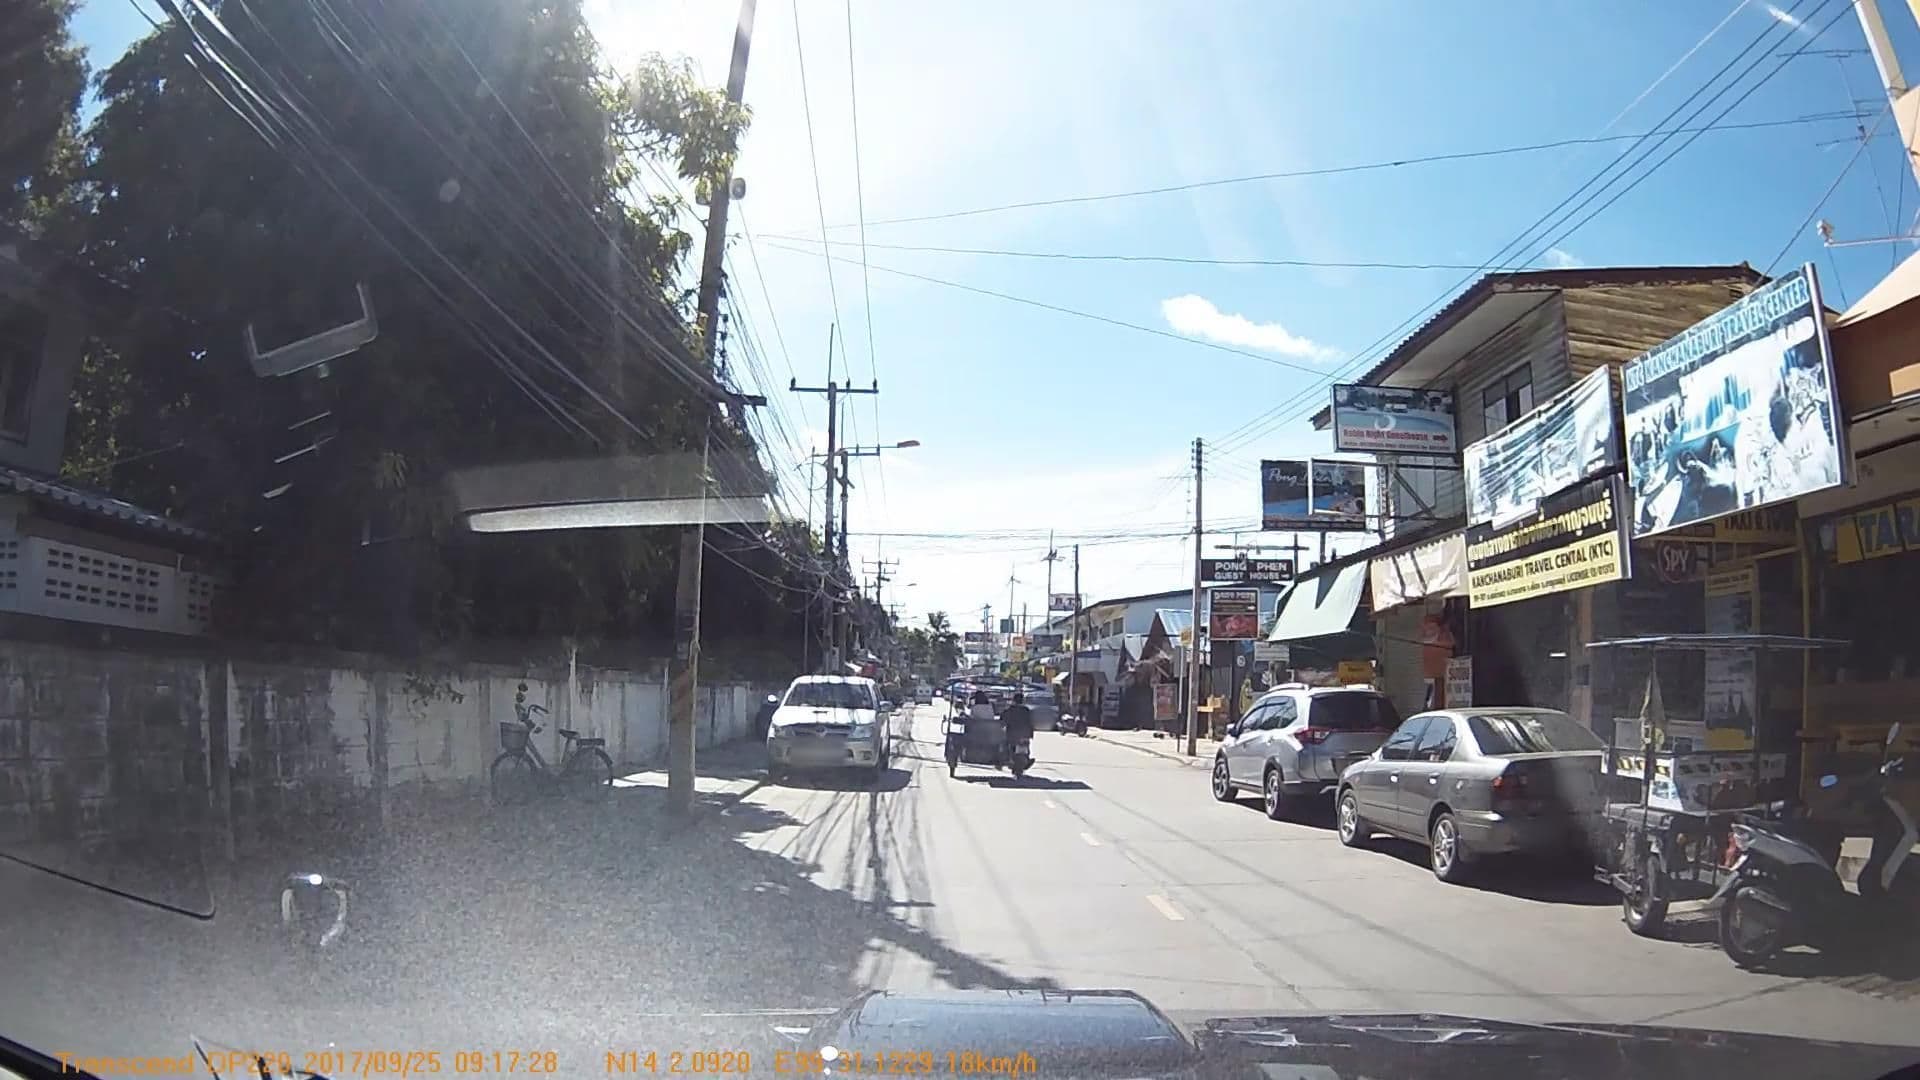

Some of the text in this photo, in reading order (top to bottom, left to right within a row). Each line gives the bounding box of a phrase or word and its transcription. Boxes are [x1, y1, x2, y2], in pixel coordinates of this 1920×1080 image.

[1644, 323, 1724, 383] KANCHANABURI
[1723, 304, 1765, 344] TRAVEL
[1764, 276, 1810, 322] CENTER
[1215, 561, 1287, 571] PONG PHEN
[1471, 566, 1525, 589] KANCHANABURI
[1524, 559, 1554, 577] TRAVEL
[1555, 550, 1587, 568] CENTAL
[1589, 540, 1614, 562] (KTC)
[1663, 545, 1689, 573] SPY
[1214, 571, 1279, 580] GUEST HOUSE
